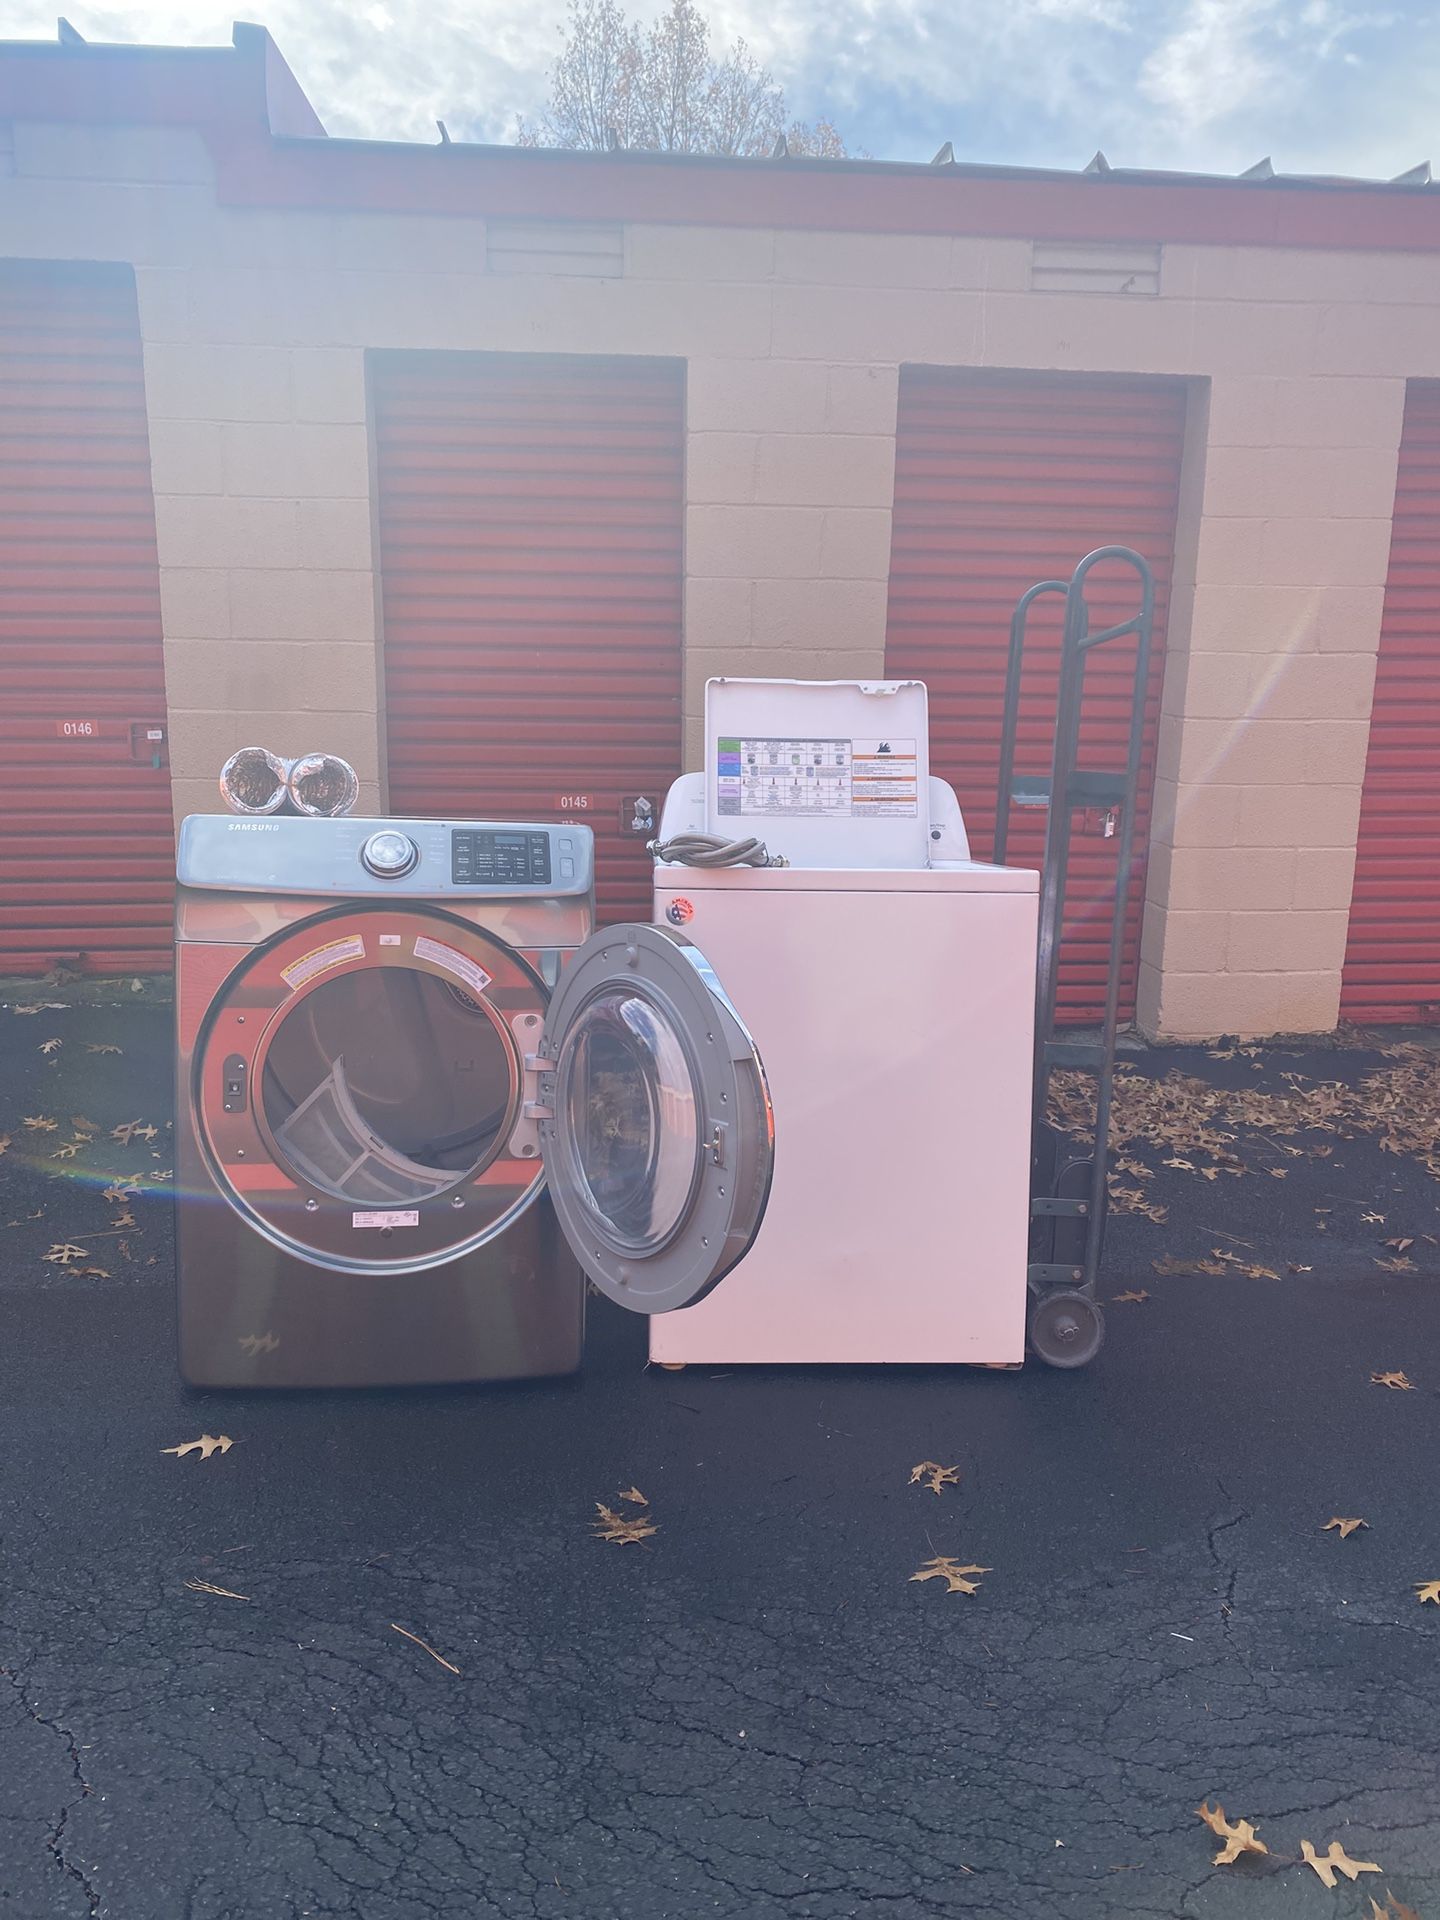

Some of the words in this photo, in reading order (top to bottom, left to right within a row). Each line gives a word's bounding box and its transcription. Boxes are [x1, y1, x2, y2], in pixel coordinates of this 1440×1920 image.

[63, 722, 92, 735] 0146
[561, 796, 588, 808] 0145
[227, 823, 280, 832] SAMSUNG
